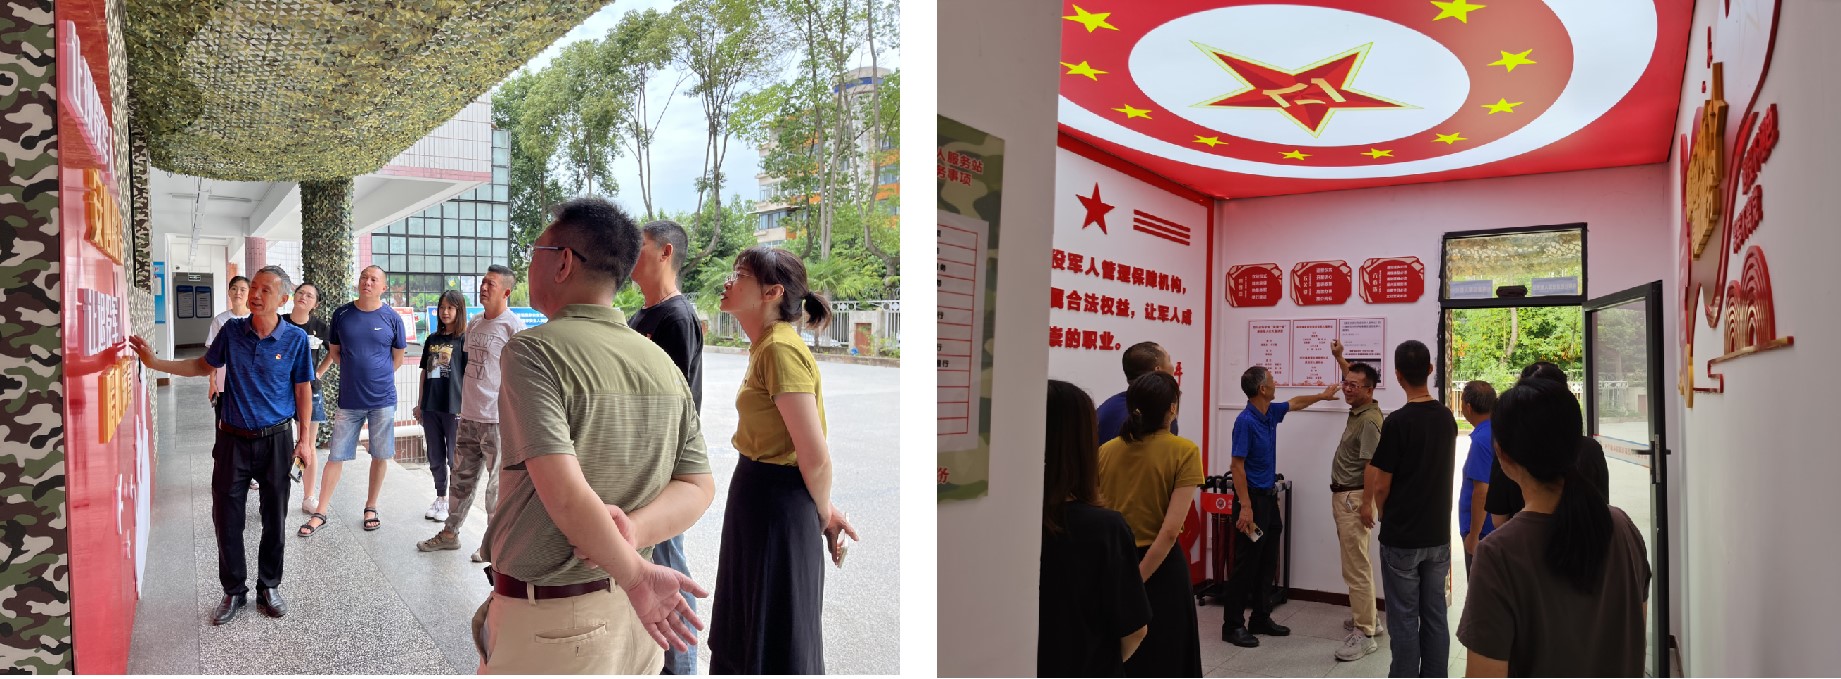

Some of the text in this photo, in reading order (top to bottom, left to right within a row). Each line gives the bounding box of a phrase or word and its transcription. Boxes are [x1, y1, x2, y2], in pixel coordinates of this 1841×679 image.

[1051, 249, 1187, 295] 役军人管理保障机构，
